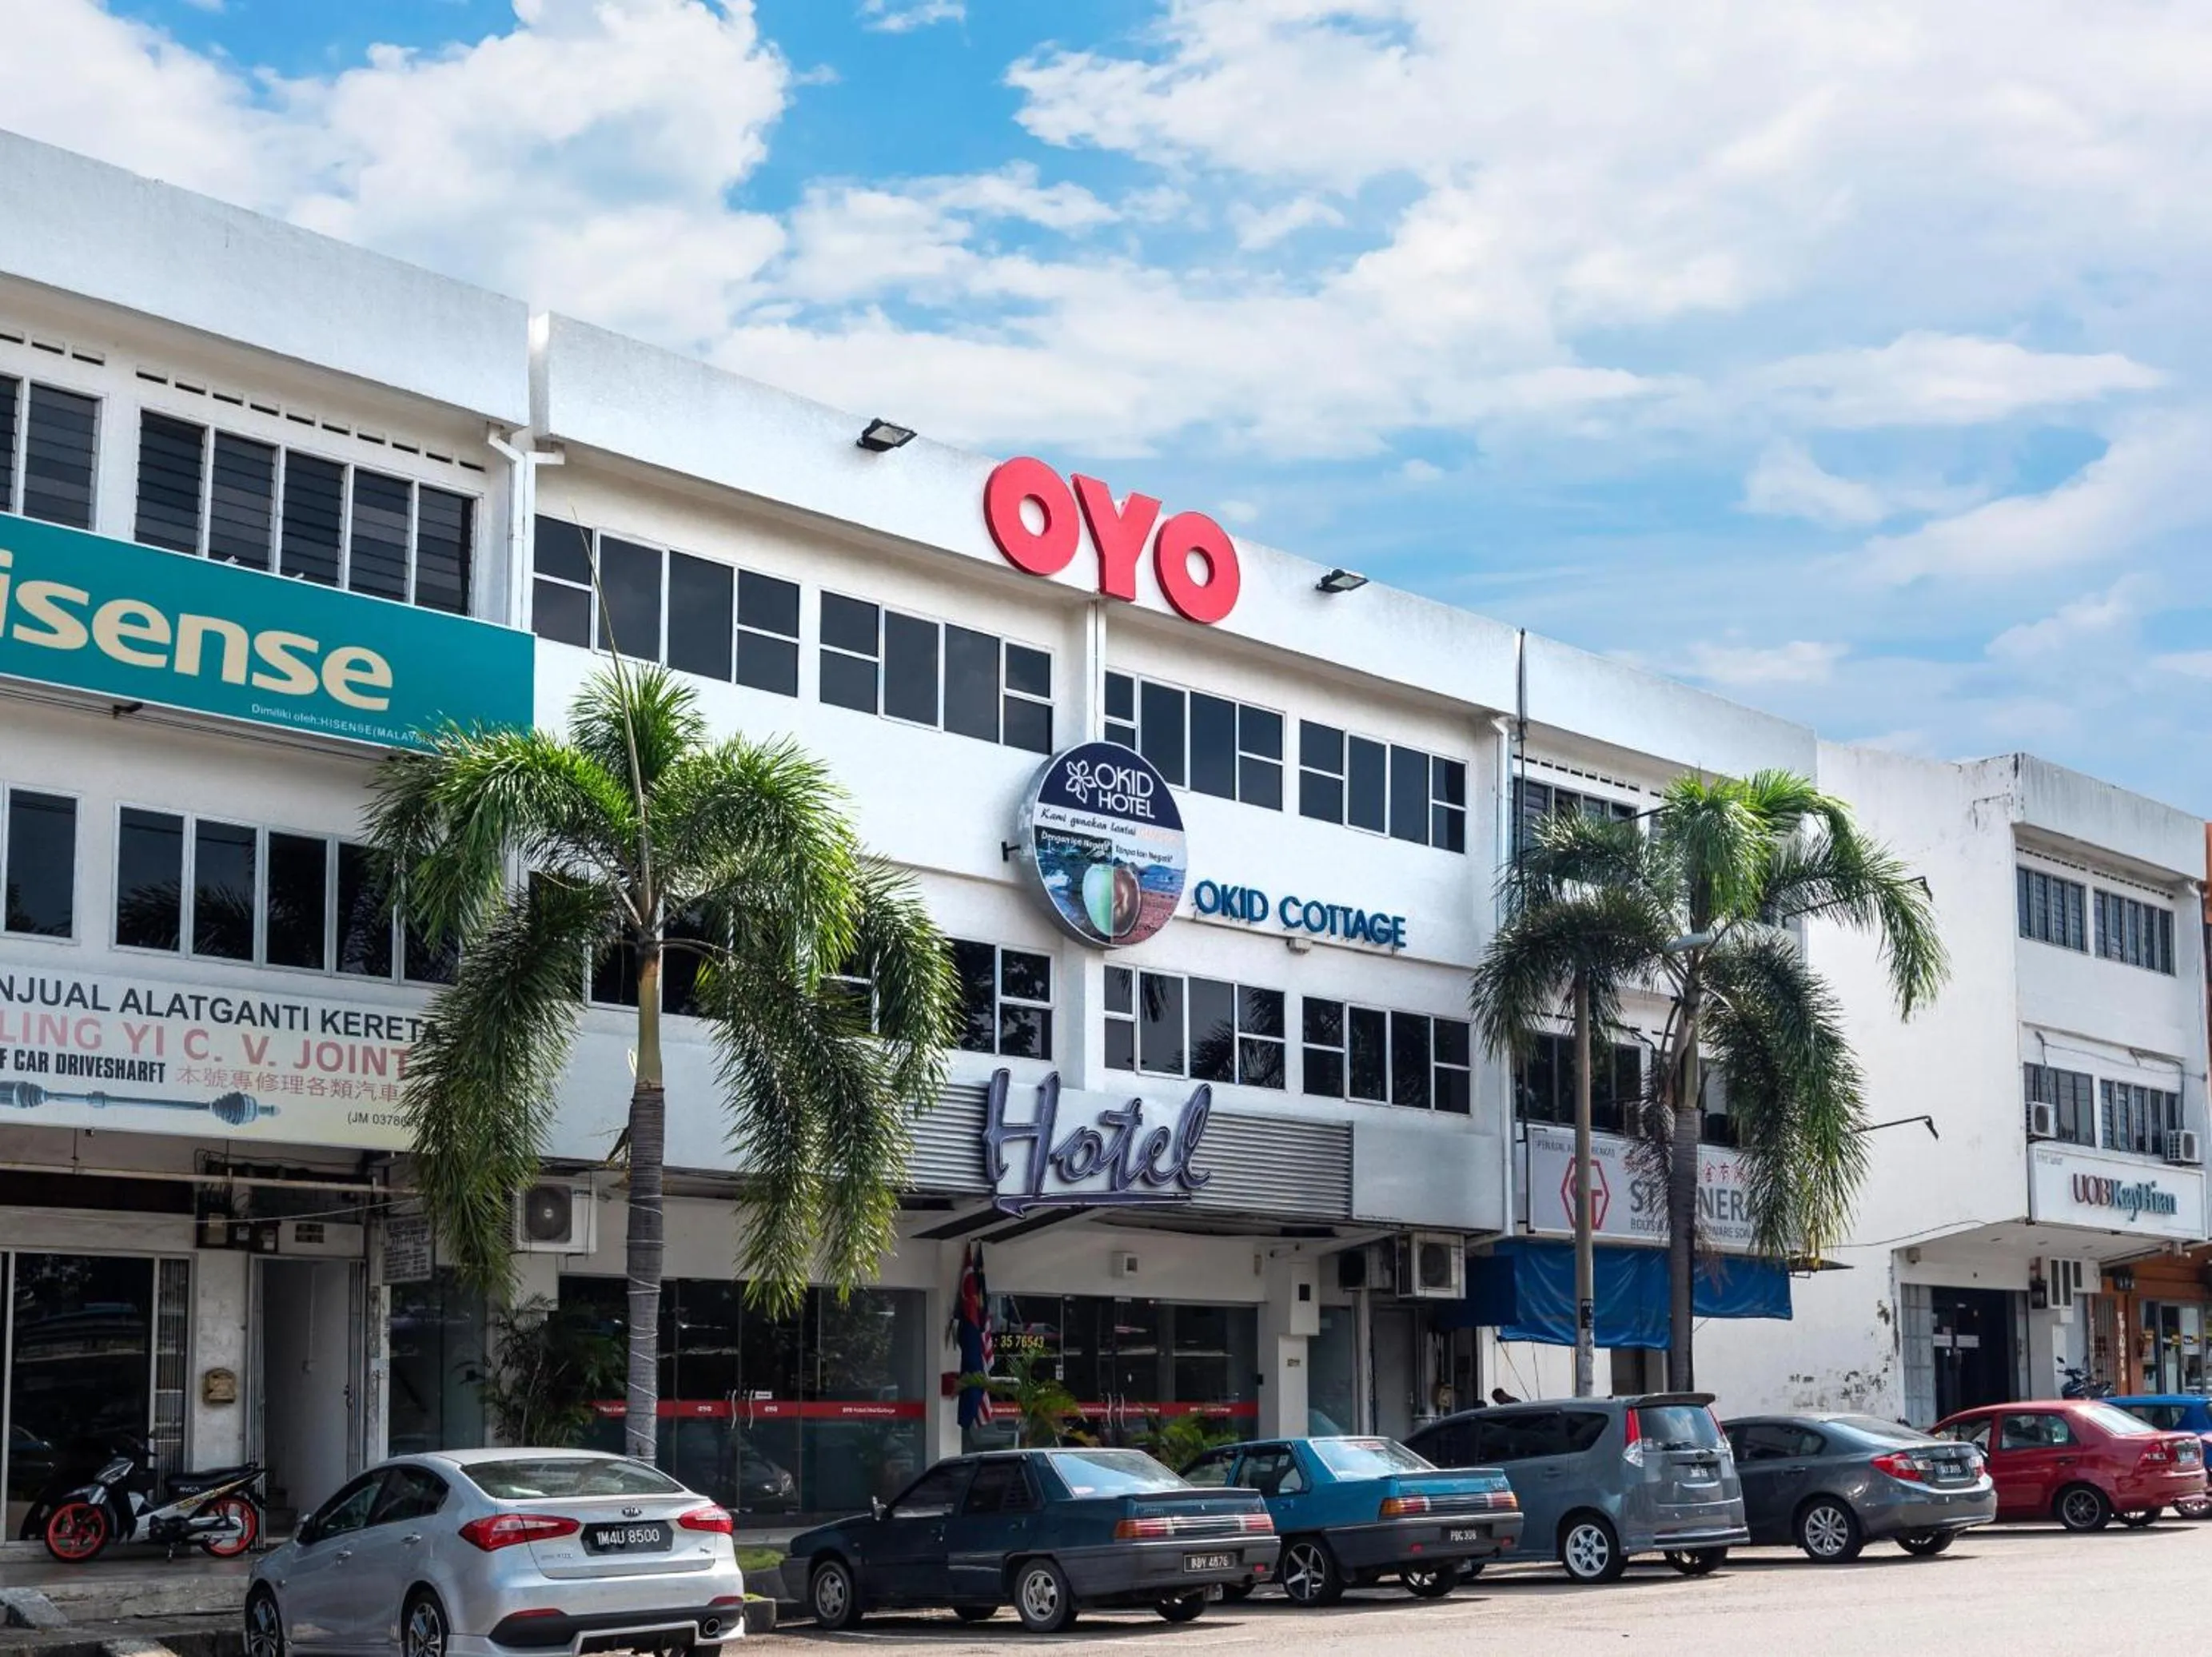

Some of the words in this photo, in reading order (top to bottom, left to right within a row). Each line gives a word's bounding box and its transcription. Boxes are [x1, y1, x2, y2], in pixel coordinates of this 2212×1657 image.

[983, 456, 1241, 623] OYO
[1094, 763, 1154, 798] OKID
[1098, 790, 1155, 819] HOTEL
[1194, 879, 1269, 922] OKID
[1279, 896, 1407, 948] COTTAGE
[119, 988, 309, 1032] ALATGANTI
[122, 1022, 165, 1056] YI
[14, 1049, 49, 1073] CAR
[56, 1053, 166, 1083] DRIVESHARFT
[982, 1068, 1214, 1203] Hotel
[628, 1529, 660, 1543] 8500
